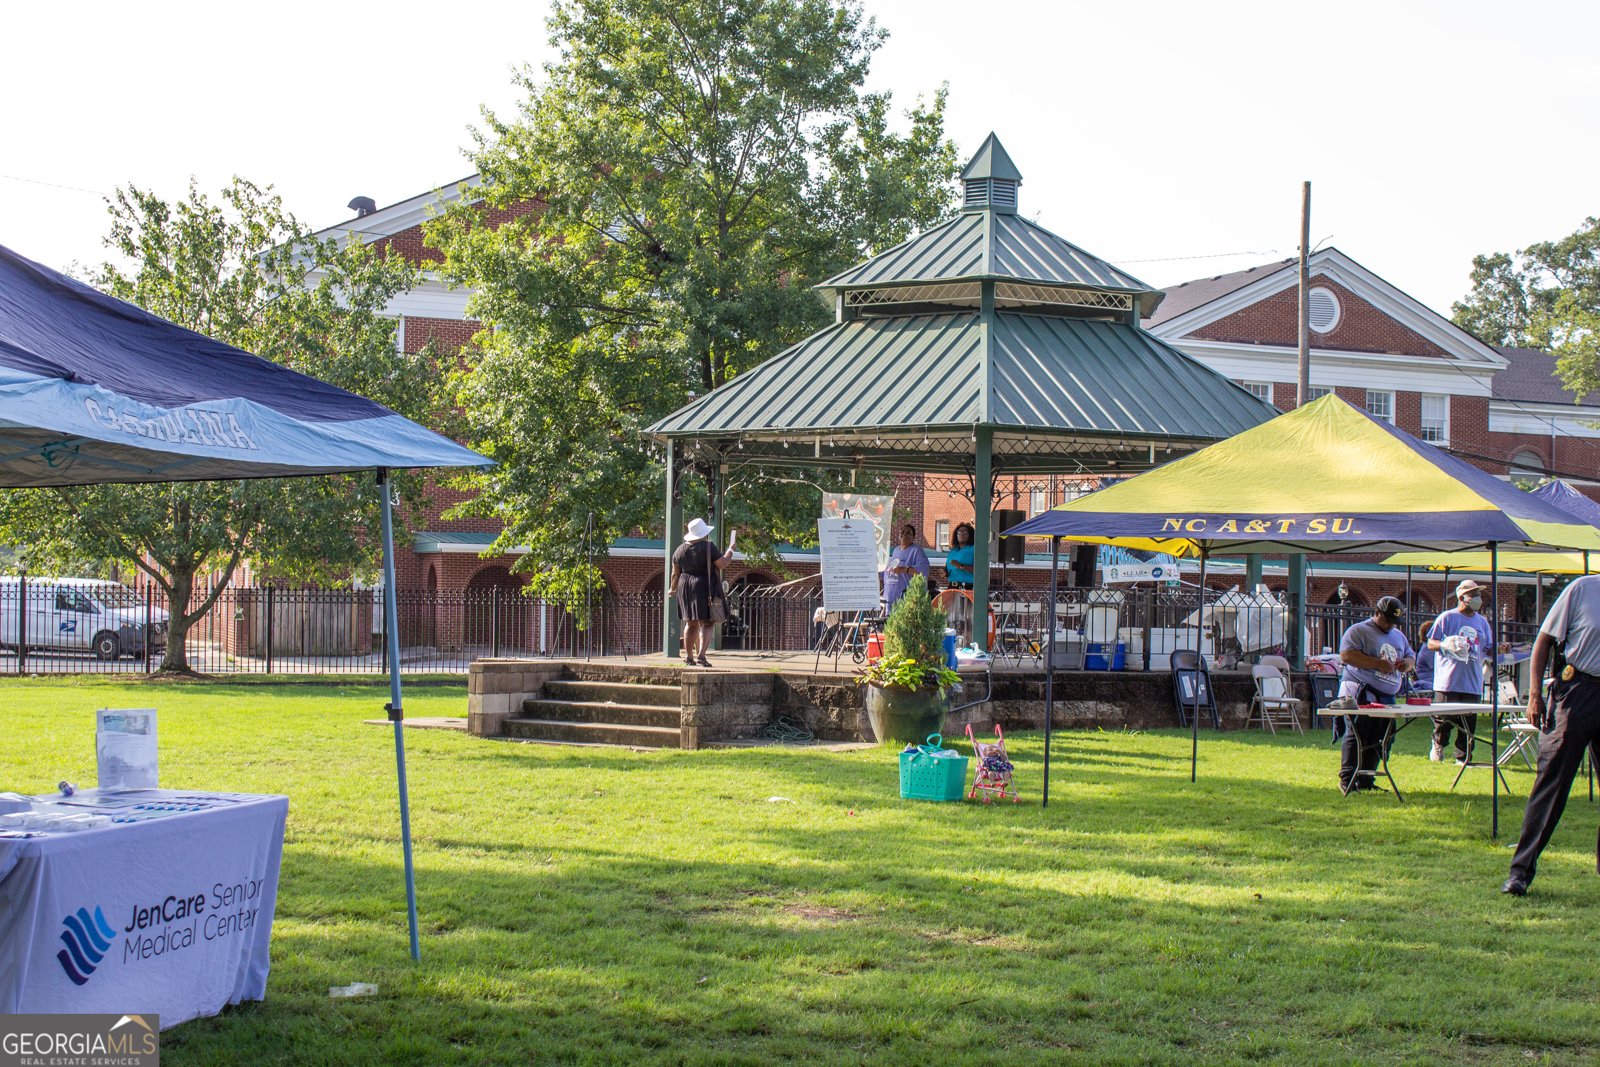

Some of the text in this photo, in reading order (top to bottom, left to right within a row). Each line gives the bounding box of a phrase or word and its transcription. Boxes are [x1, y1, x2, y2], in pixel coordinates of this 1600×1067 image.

[1160, 518, 1207, 532] NC
[1216, 519, 1295, 533] A&T
[125, 876, 263, 933] JenCare Senior
[123, 907, 260, 964] Medical Center
